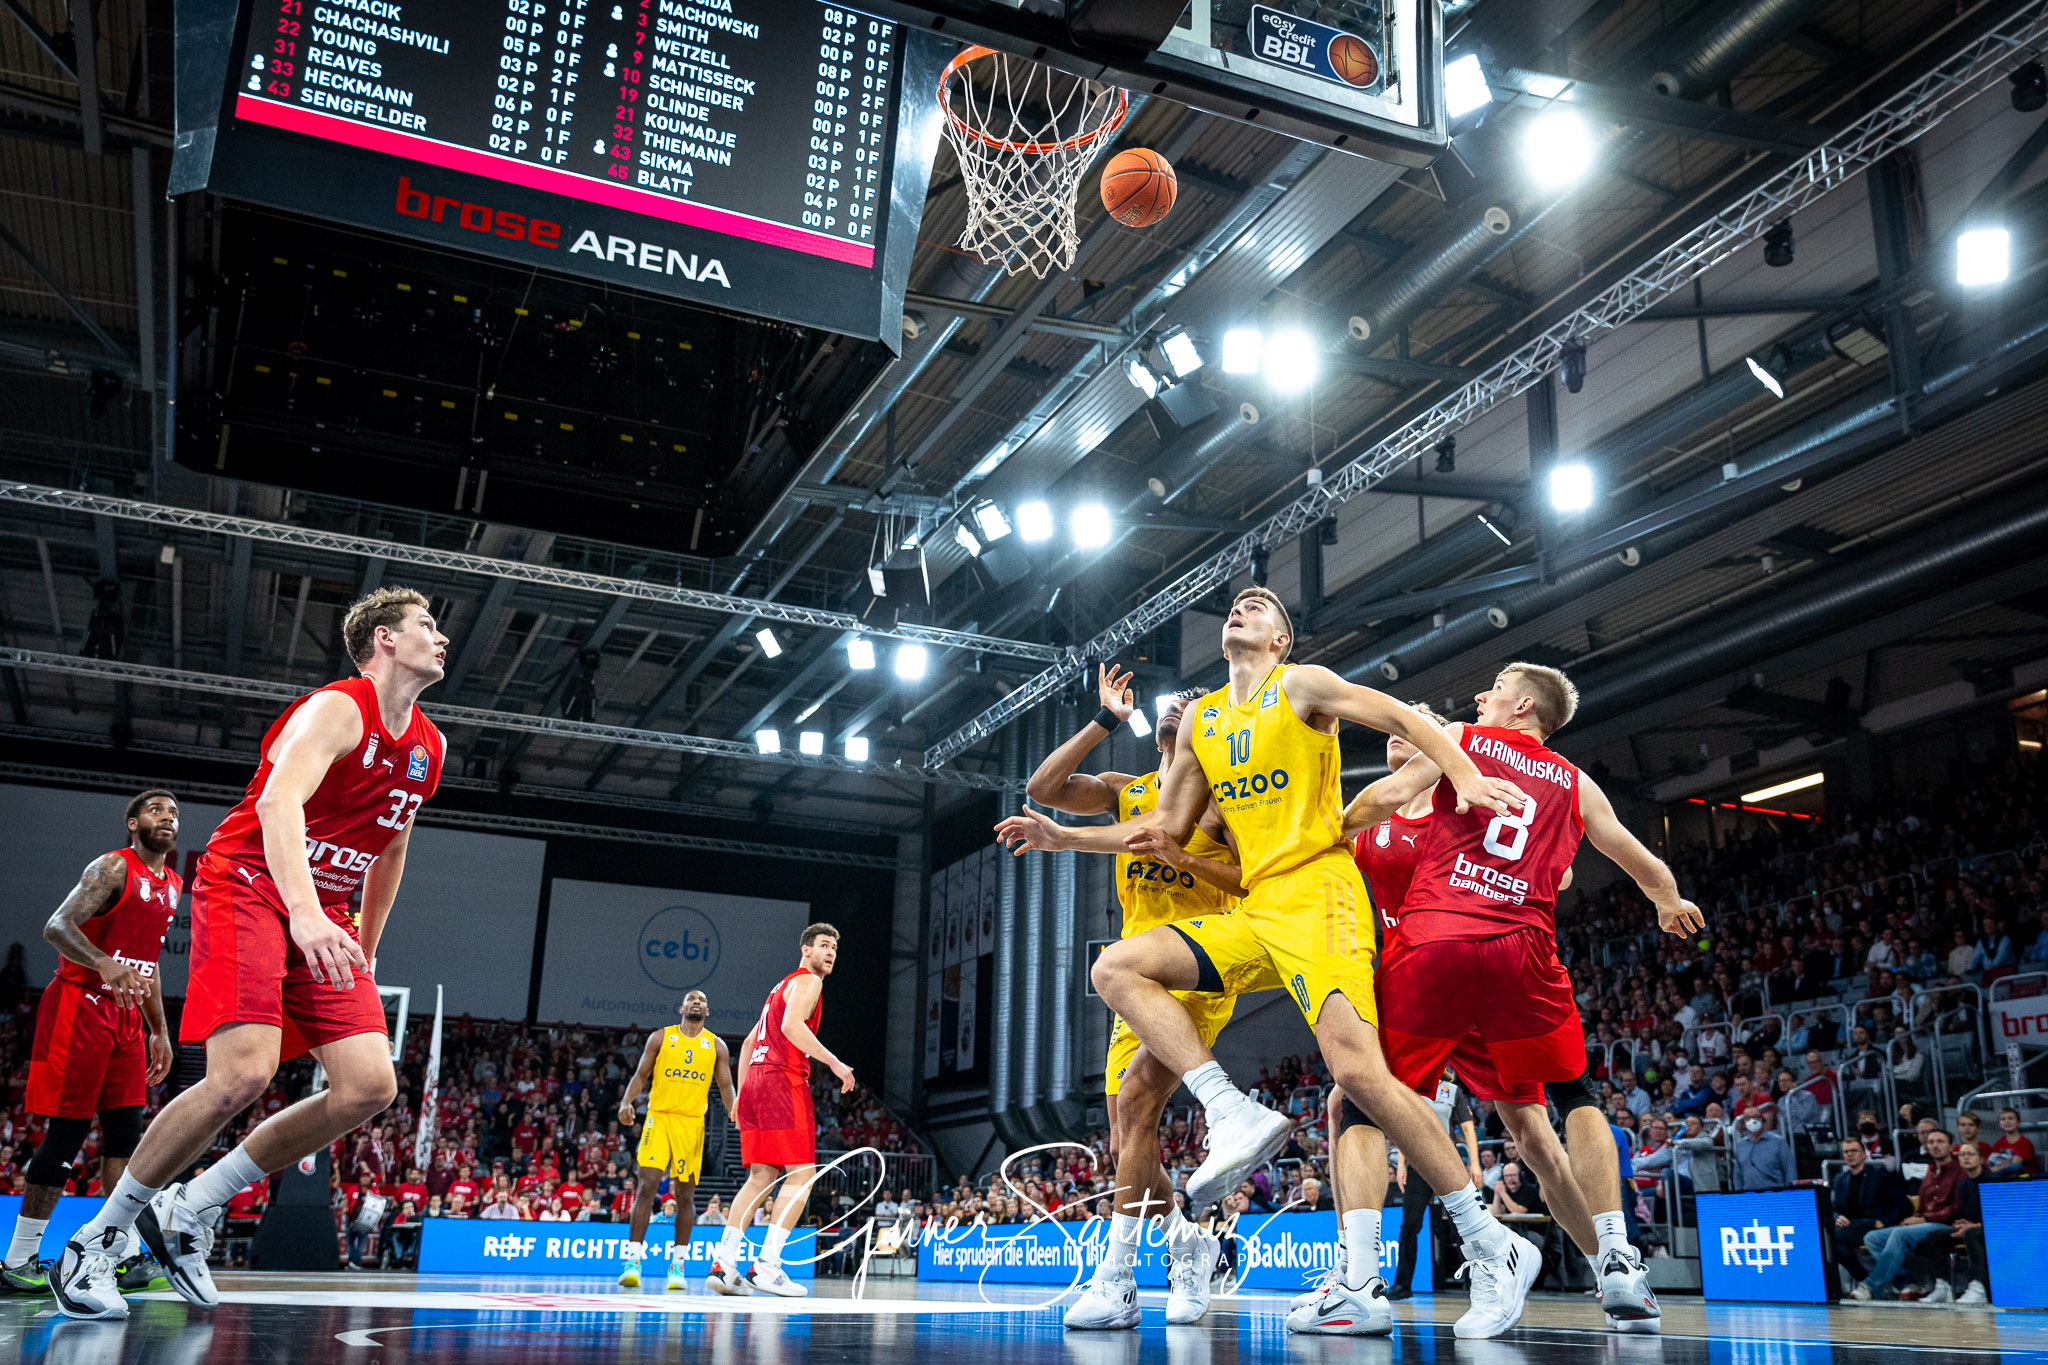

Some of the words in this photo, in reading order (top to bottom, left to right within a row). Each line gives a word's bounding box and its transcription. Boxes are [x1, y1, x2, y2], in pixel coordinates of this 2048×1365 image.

[281, 0, 302, 15] 21
[314, 7, 450, 54] CHACHASHVILI
[501, 55, 522, 72] 03
[526, 61, 538, 75] P
[552, 69, 563, 84] 2
[566, 72, 578, 86] F
[505, 16, 527, 34] 00
[531, 22, 543, 36] P
[557, 30, 568, 45] 0
[572, 33, 583, 47] F
[510, 0, 529, 15] 02
[534, 4, 546, 18] P
[560, 11, 570, 25] 0
[574, 14, 586, 28] F
[659, 0, 759, 39] MACHOWSKI
[820, 45, 839, 61] 00
[842, 50, 853, 63] P
[865, 57, 875, 70] 0
[878, 60, 888, 74] F
[822, 27, 841, 43] 02
[844, 33, 855, 46] P
[867, 39, 877, 52] 0
[880, 42, 890, 56] F
[824, 8, 843, 24] 08
[847, 14, 857, 27] P
[869, 21, 879, 35] 0
[882, 25, 892, 38] F
[1278, 27, 1316, 48] Credit
[274, 39, 295, 56] 31
[307, 46, 382, 78] REAVES
[495, 95, 516, 112] 06
[520, 100, 532, 114] P
[546, 107, 557, 122] 0
[561, 110, 573, 125] F
[277, 18, 300, 36] 22
[312, 25, 377, 55] YOUNG
[498, 75, 519, 93] 02
[523, 80, 535, 95] P
[551, 88, 559, 103] 1
[564, 91, 576, 105] F
[503, 36, 524, 53] 05
[528, 42, 540, 56] P
[555, 50, 565, 64] 0
[569, 52, 581, 67] F
[636, 31, 645, 45] 7
[654, 35, 731, 69] WETZELL
[816, 81, 835, 97] 00
[838, 87, 849, 100] P
[861, 93, 871, 107] 2
[874, 96, 884, 109] F
[638, 13, 648, 26] 3
[656, 18, 709, 44] SMITH
[818, 63, 837, 79] 08
[840, 68, 851, 81] P
[863, 75, 873, 89] 0
[876, 78, 887, 92] F
[1262, 35, 1316, 69] BBL
[271, 59, 294, 76] 33
[304, 66, 413, 107] HECKMANN
[492, 114, 513, 132] 02
[517, 120, 530, 134] P
[545, 127, 553, 142] 1
[559, 130, 571, 144] F
[622, 67, 640, 83] 10
[649, 74, 744, 111] SCHNEIDER
[812, 118, 832, 134] 00
[834, 123, 845, 136] P
[858, 130, 866, 144] 1
[870, 132, 881, 146] F
[633, 51, 643, 64] 9
[652, 55, 755, 95] MATTISSECK
[814, 99, 833, 115] 00
[836, 105, 847, 118] P
[859, 112, 869, 125] 0
[872, 114, 883, 128] F
[267, 80, 290, 97] 43
[300, 88, 427, 131] SENGFELDER
[489, 134, 511, 151] 02
[515, 140, 527, 154] P
[541, 147, 552, 161] 0
[556, 150, 568, 164] F
[615, 105, 634, 122] 21
[645, 112, 737, 148] KOUMADJE
[808, 154, 828, 171] 03
[831, 160, 842, 173] P
[855, 166, 862, 180] 1
[866, 169, 877, 183] F
[620, 86, 638, 102] 19
[647, 94, 710, 122] OLINDE
[810, 136, 829, 152] 04
[832, 141, 843, 155] P
[855, 148, 866, 161] 0
[868, 150, 879, 164] F
[610, 144, 631, 160] 43
[639, 151, 694, 177] SIKMA
[804, 192, 823, 208] 04
[826, 197, 838, 211] P
[850, 203, 860, 217] 0
[863, 206, 874, 220] F
[613, 124, 633, 141] 32
[643, 131, 732, 167] THIEMANN
[806, 173, 826, 190] 02
[828, 178, 840, 192] P
[853, 185, 860, 198] 1
[864, 187, 875, 201] F
[396, 177, 561, 249] brose
[569, 230, 732, 288] ARENA
[607, 163, 628, 179] 45
[637, 169, 693, 195] BLATT
[801, 210, 822, 227] 00
[824, 215, 836, 230] P
[847, 222, 858, 236] 0
[860, 224, 872, 239] F
[1226, 729, 1251, 766] 10
[1469, 733, 1572, 790] KARINIAUSKAS
[376, 788, 423, 831] 33
[1483, 792, 1537, 861] 8
[1449, 873, 1525, 906] bamberg
[1454, 853, 1529, 896] brose
[645, 929, 710, 962] cebi
[1291, 973, 1311, 1014] 10
[684, 1049, 694, 1064] 3
[676, 1158, 686, 1175] 3
[933, 1241, 956, 1266] Hier
[956, 1240, 1003, 1272] sprudeln
[1004, 1239, 1022, 1266] die
[1026, 1238, 1061, 1266] Ideen
